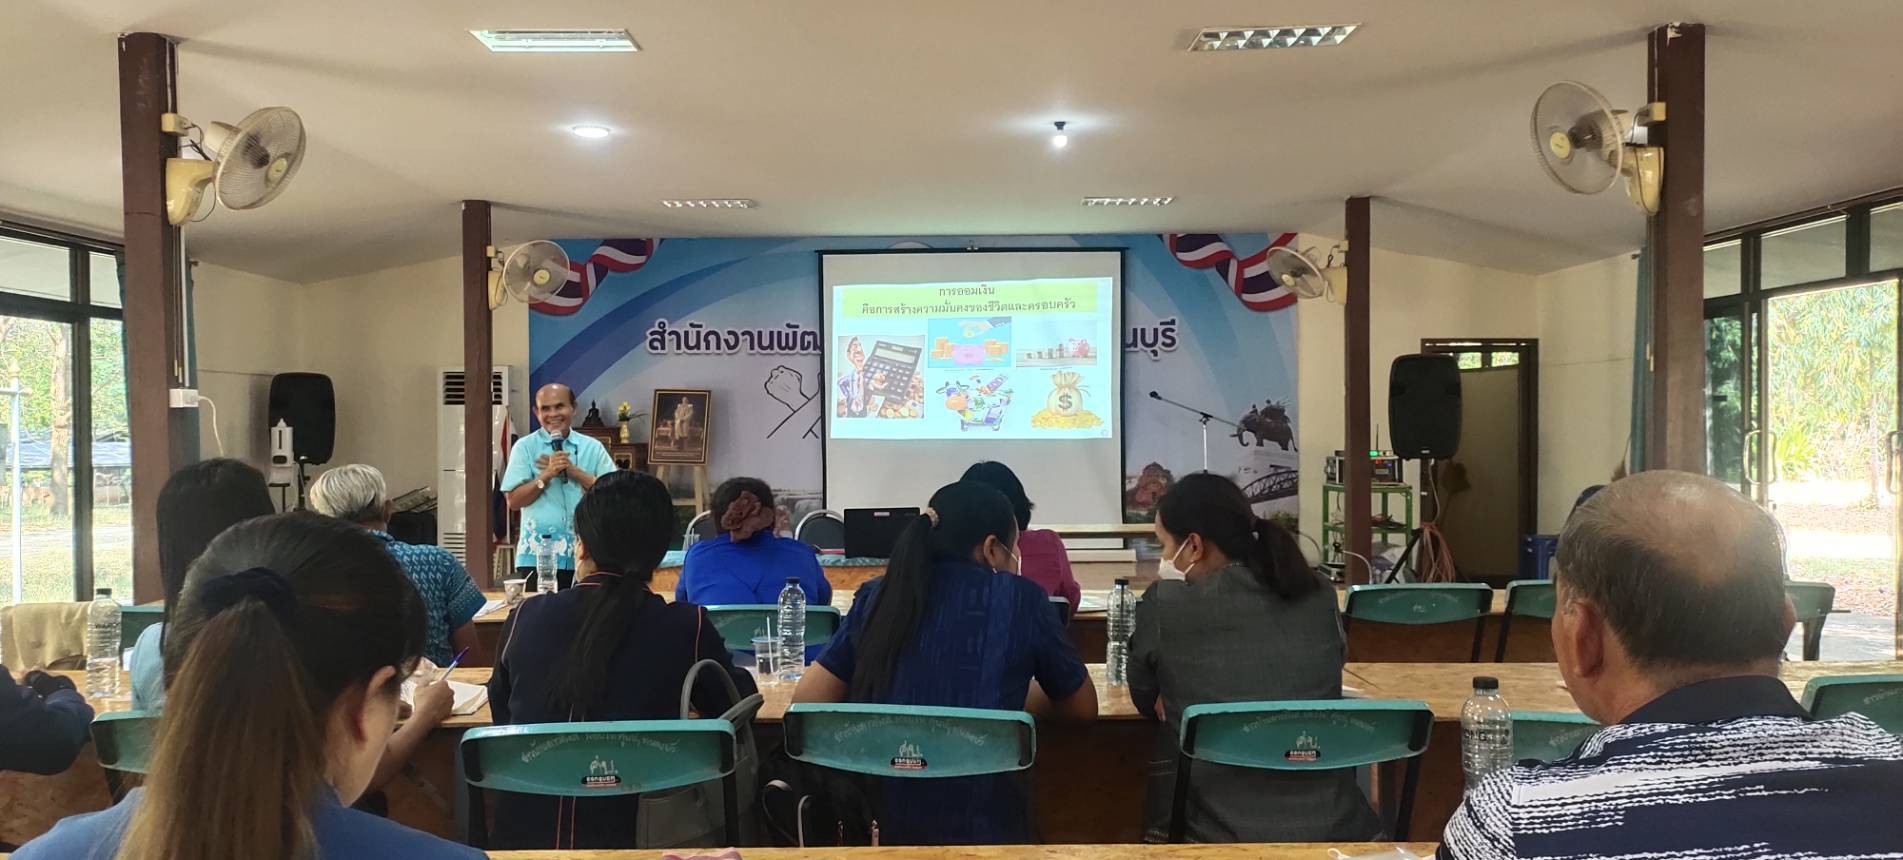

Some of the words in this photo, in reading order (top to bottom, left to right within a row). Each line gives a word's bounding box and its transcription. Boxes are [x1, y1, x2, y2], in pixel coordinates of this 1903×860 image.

[939, 283, 996, 297] การออมเงิน
[861, 298, 1076, 315] คือการสร้างความมั่นคงของชีวิตและครอบครัว
